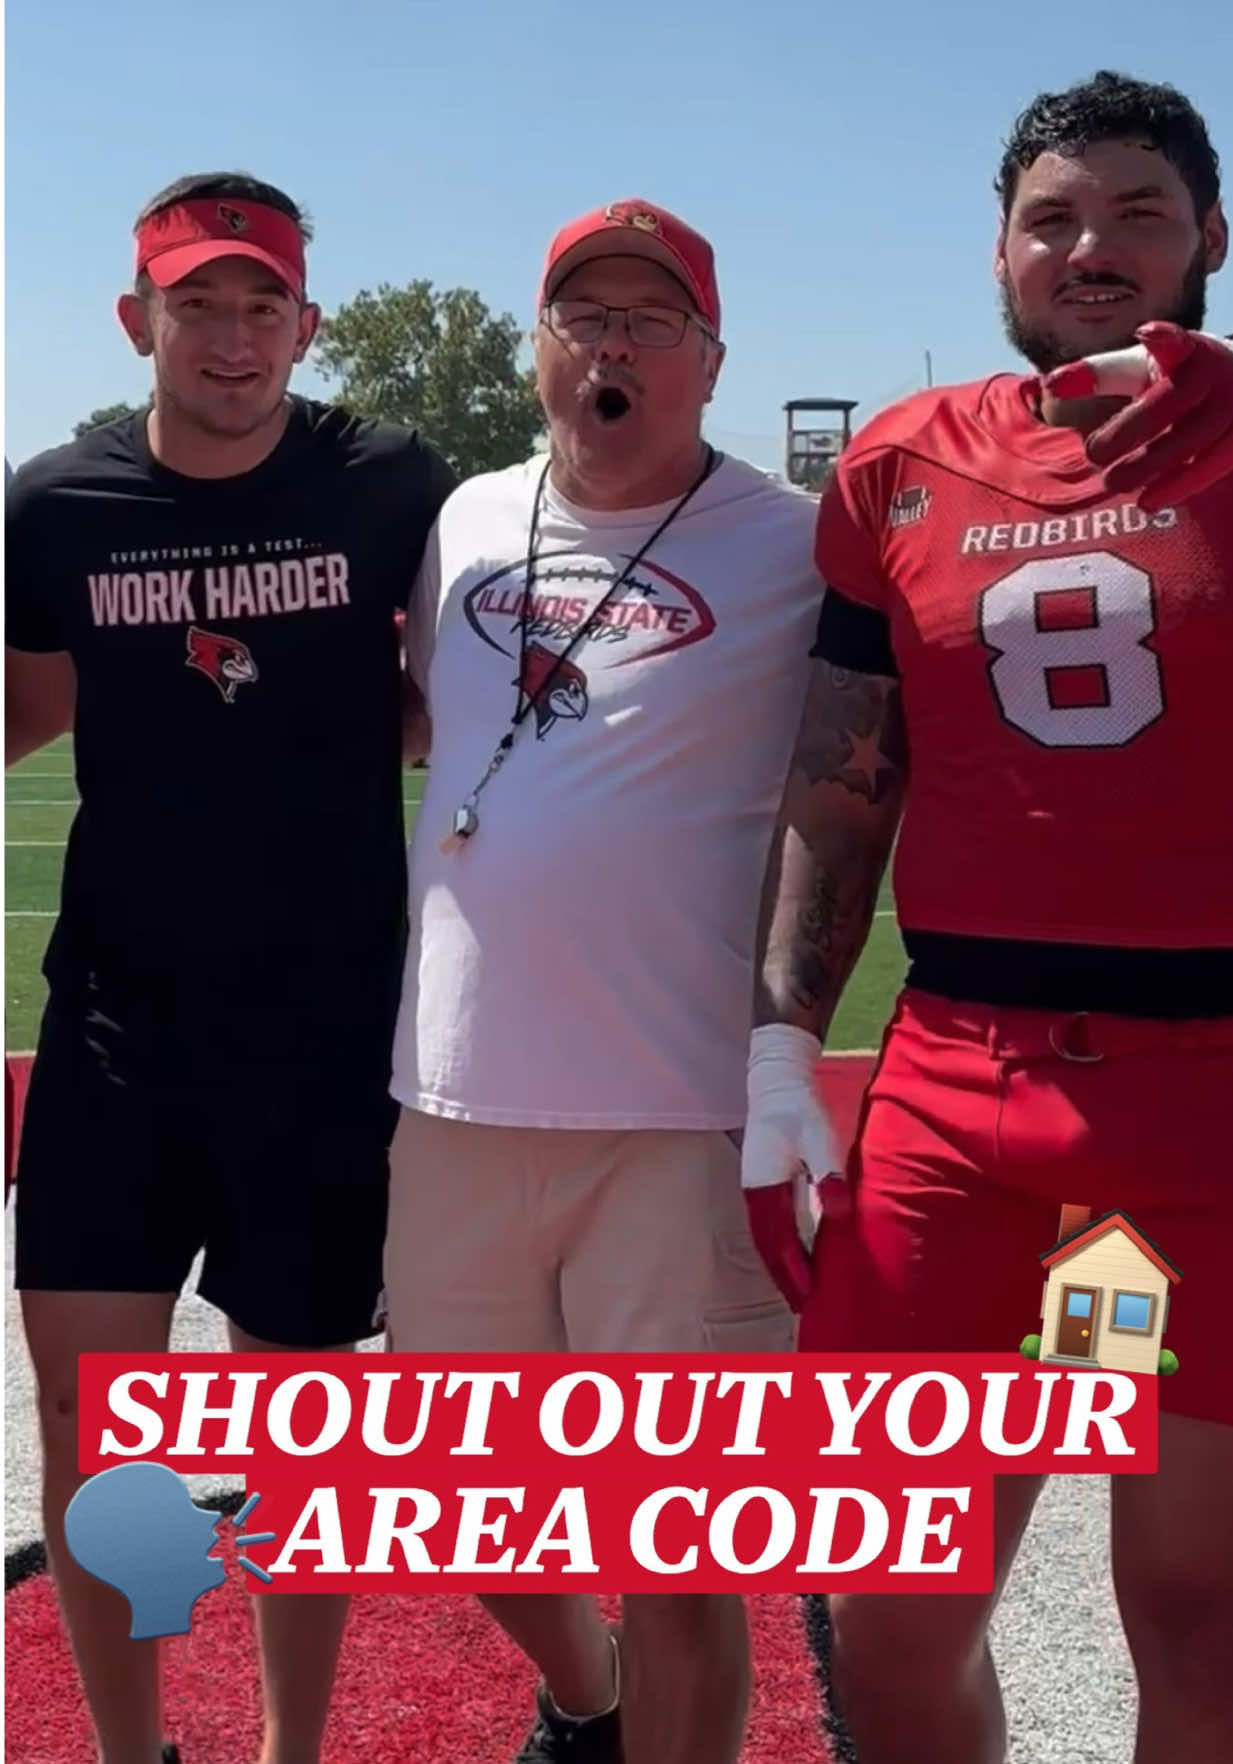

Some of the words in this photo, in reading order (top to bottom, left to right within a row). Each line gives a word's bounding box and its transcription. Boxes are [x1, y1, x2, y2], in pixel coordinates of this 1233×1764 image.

[111, 546, 213, 564] EVERYTHING
[248, 543, 256, 553] A
[88, 569, 197, 626] WORK
[204, 553, 351, 620] HARDER
[598, 601, 692, 634] STATE
[979, 551, 1164, 747] 8
